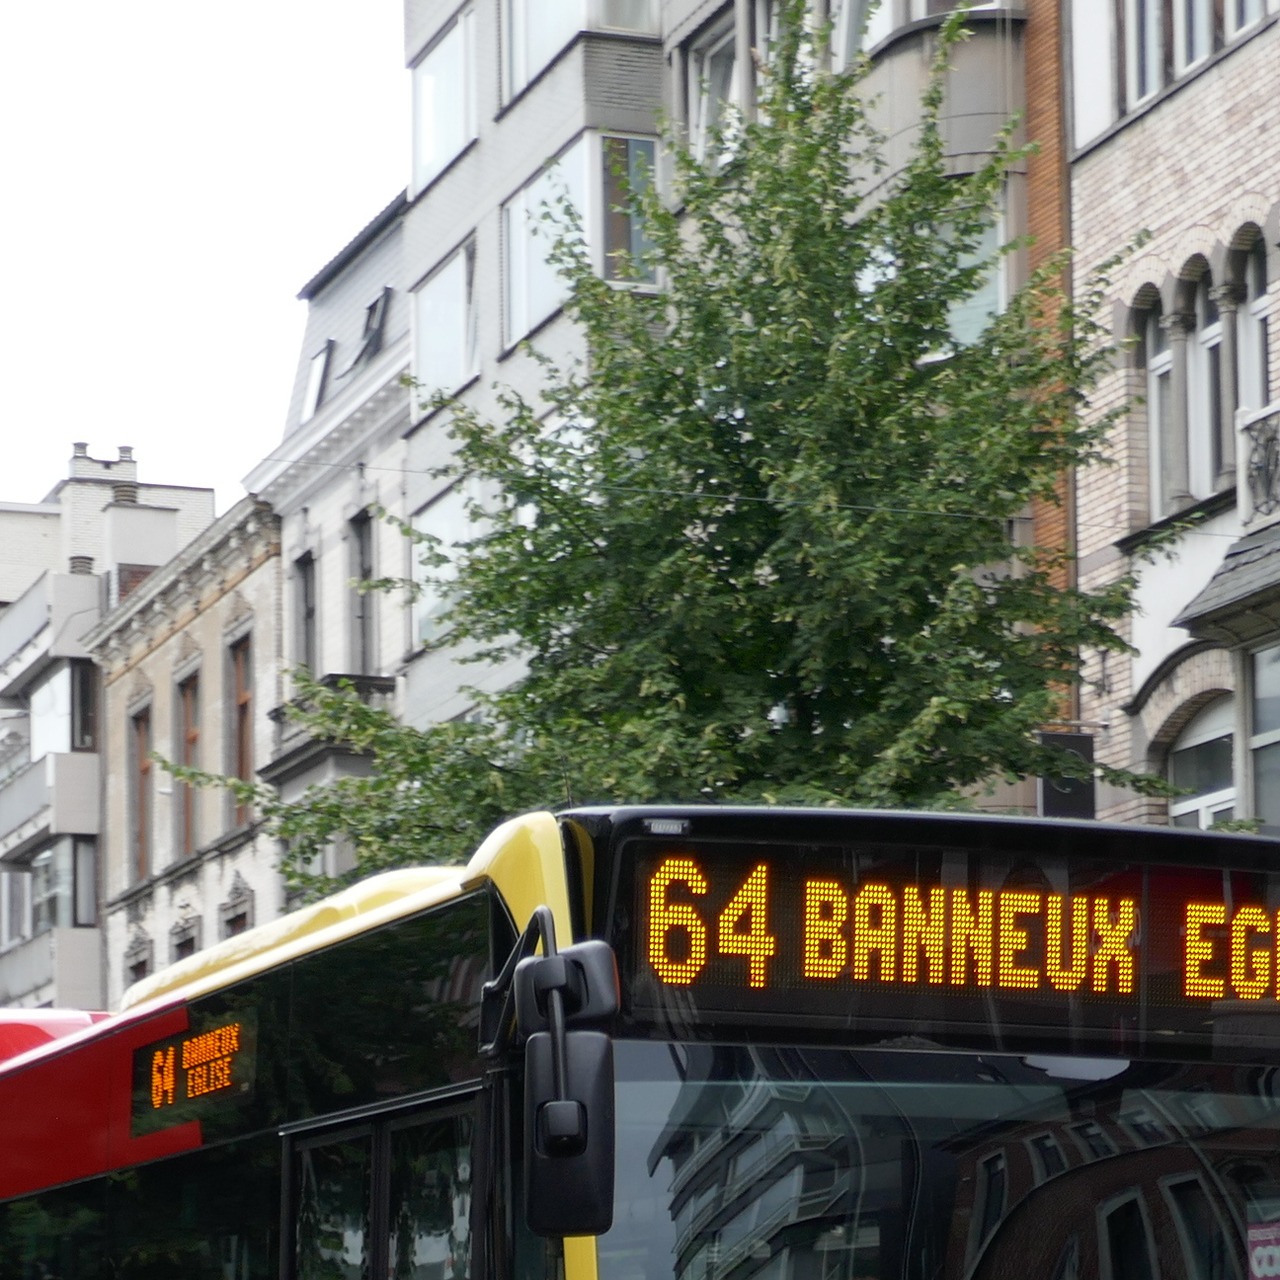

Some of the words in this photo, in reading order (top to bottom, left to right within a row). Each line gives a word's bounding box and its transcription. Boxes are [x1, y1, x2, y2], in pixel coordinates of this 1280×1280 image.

[648, 857, 775, 989] 64
[803, 879, 1135, 994] BANNEUX
[151, 1045, 175, 1109] 64
[181, 1022, 239, 1070] BANNEUX
[187, 1056, 232, 1099] EGLISE
